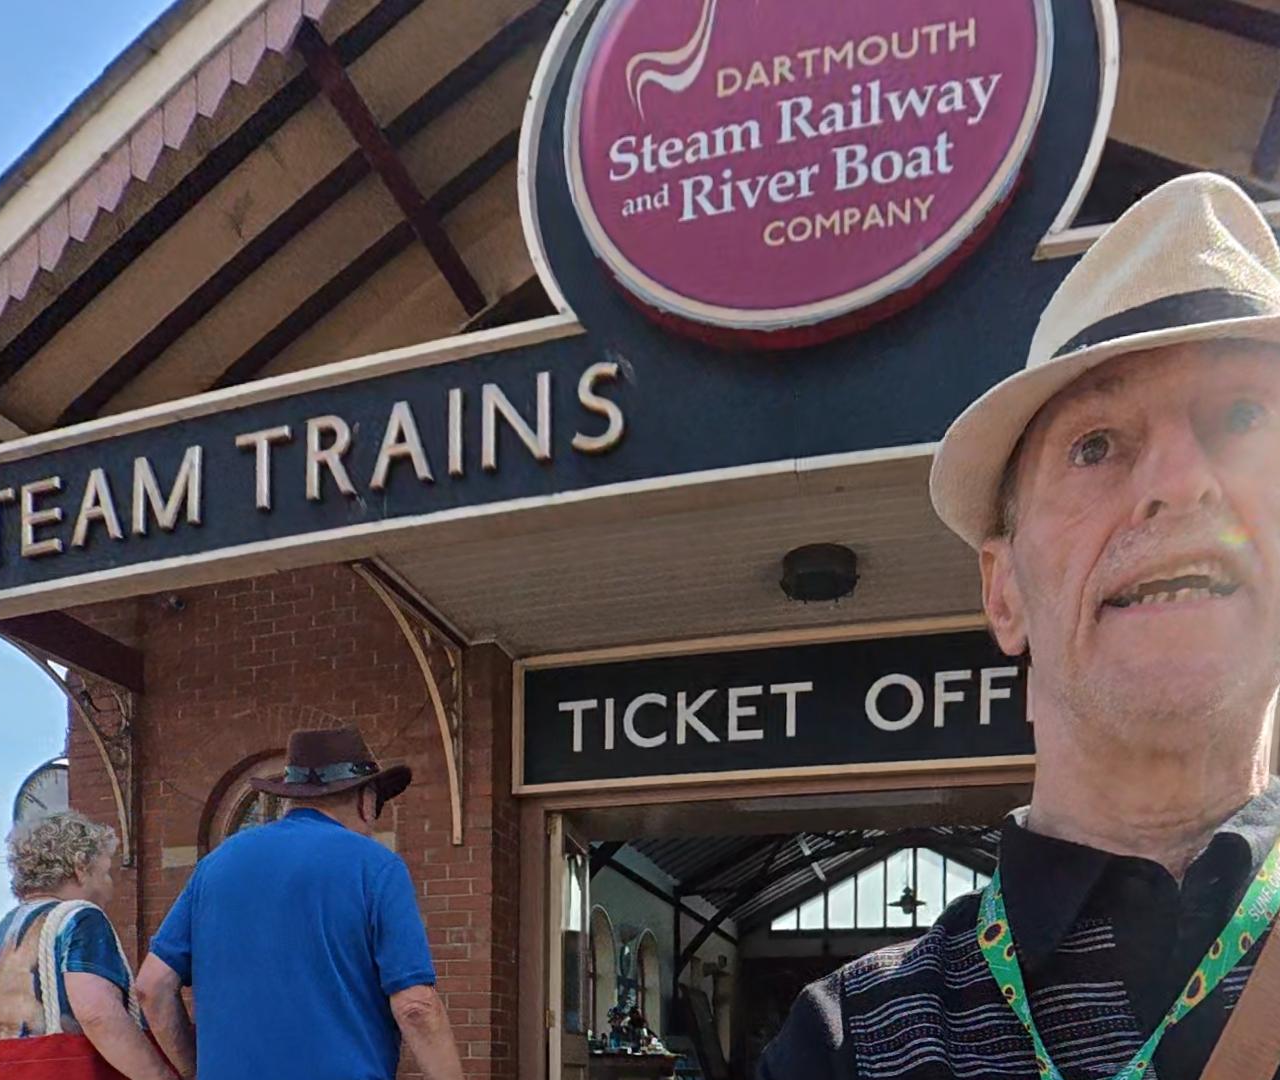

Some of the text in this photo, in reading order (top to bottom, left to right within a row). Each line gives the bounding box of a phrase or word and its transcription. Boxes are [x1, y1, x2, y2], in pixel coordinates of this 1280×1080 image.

[716, 18, 977, 98] DARTMOUTH
[608, 73, 1002, 182] Steam Railway
[621, 137, 954, 221] and River Boat
[763, 195, 935, 247] COMPANY
[234, 361, 626, 511] TRAINS
[558, 681, 814, 753] TICKET
